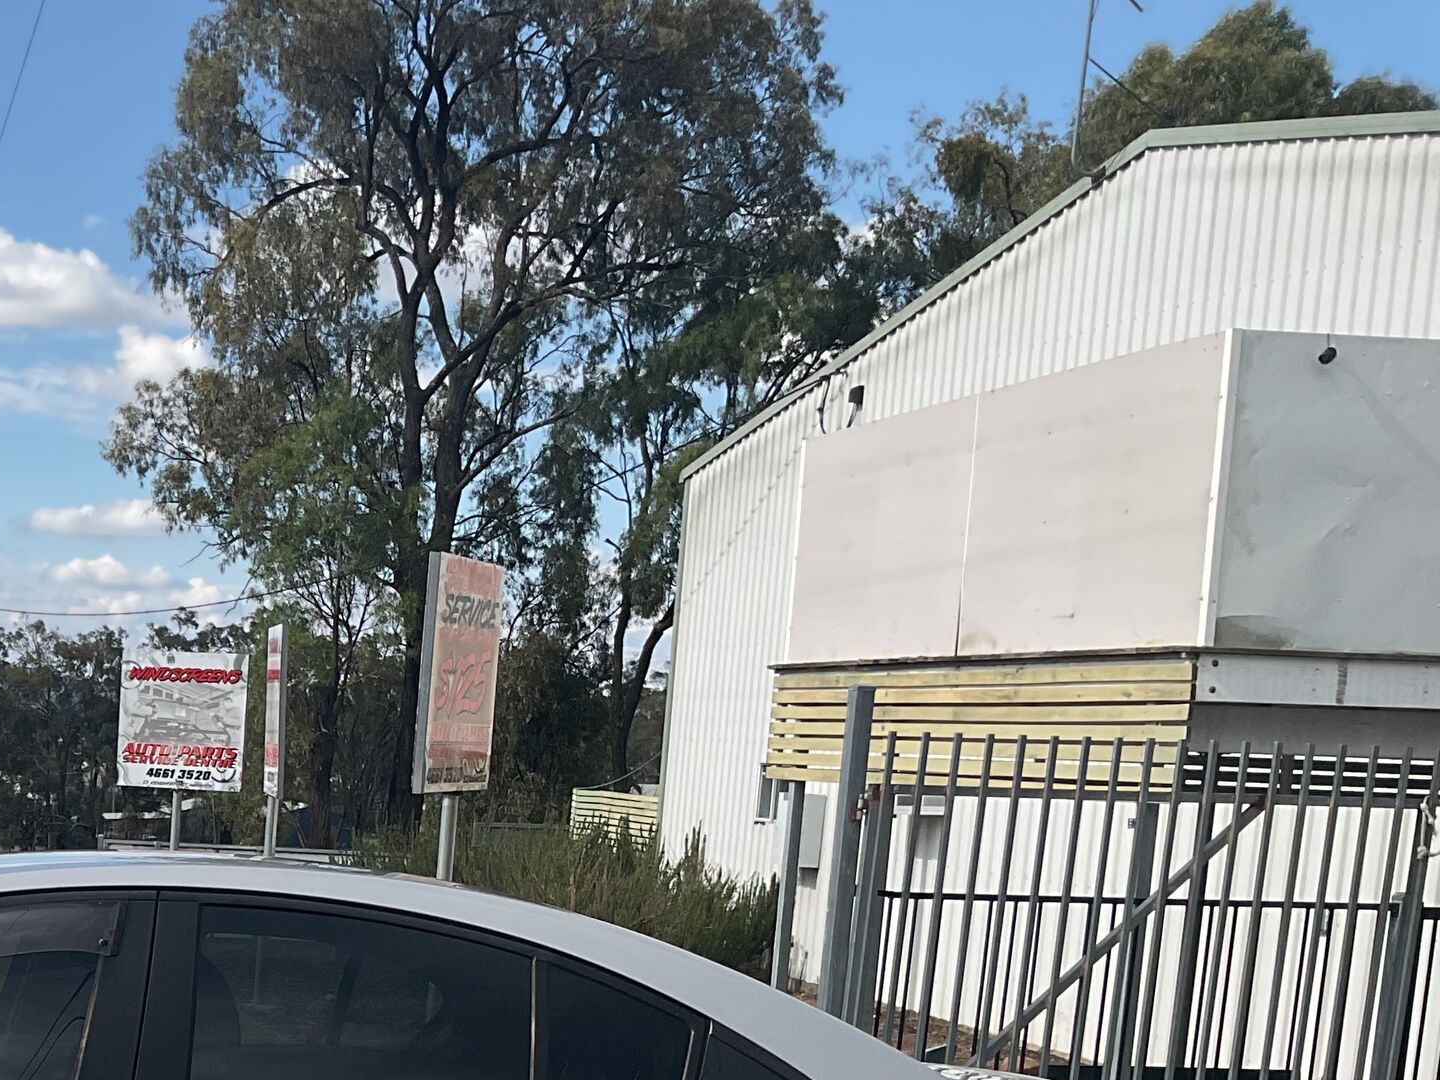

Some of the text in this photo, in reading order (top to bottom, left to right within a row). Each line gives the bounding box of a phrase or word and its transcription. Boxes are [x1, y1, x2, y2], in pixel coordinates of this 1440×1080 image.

[442, 593, 499, 630] SERVICE
[129, 667, 242, 685] WINDSCREENS
[122, 743, 238, 761] AUTO PARTS
[122, 754, 237, 768] SERVICE CENTRE
[146, 768, 211, 780] 4661 3520
